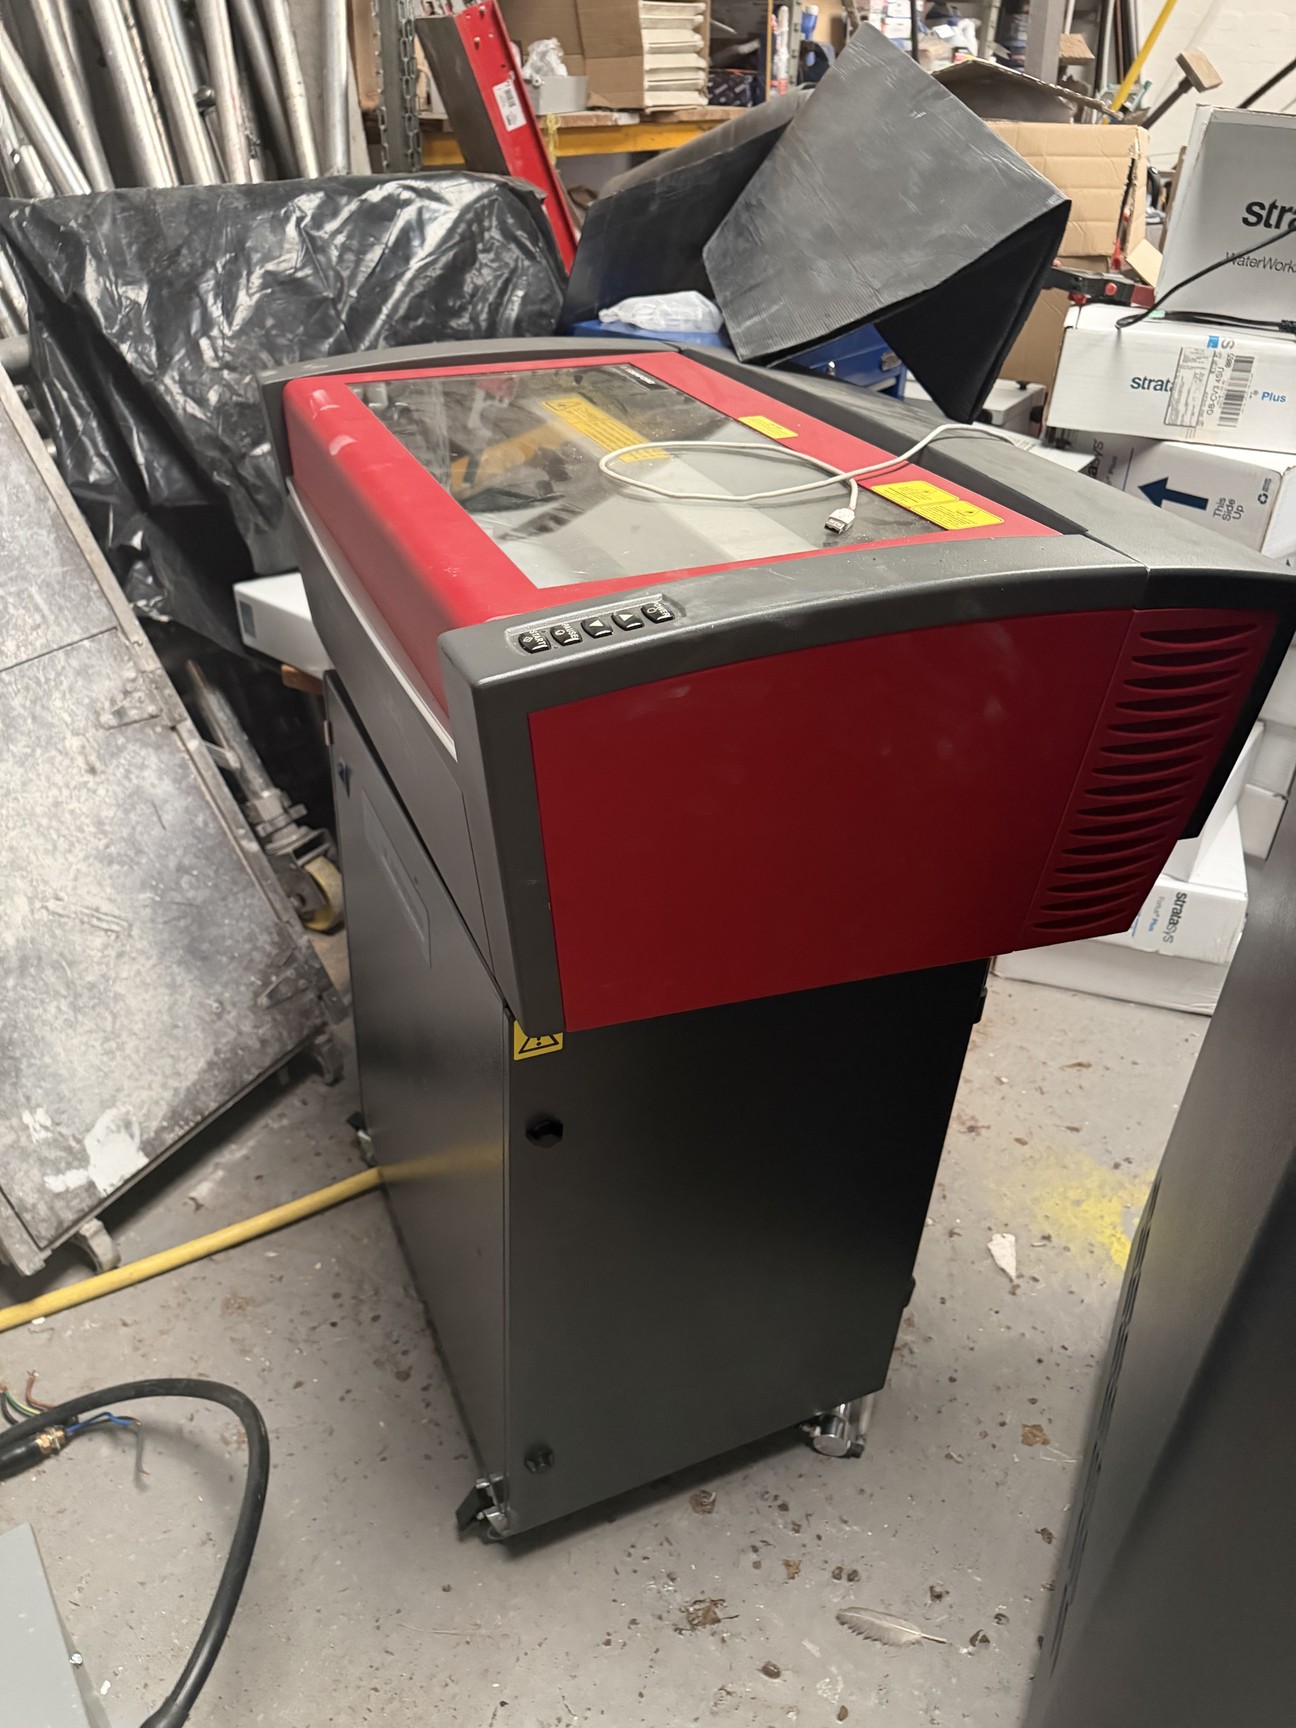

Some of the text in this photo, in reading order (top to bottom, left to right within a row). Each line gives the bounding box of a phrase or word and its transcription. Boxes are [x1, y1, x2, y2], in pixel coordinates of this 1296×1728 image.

[1225, 251, 1296, 273] WaterWork
[1261, 391, 1288, 403] Plus
[1213, 497, 1226, 517] This
[1221, 498, 1236, 521] Side
[1231, 505, 1245, 520] Up
[529, 628, 547, 645] START
[1162, 891, 1188, 944] stratasys
